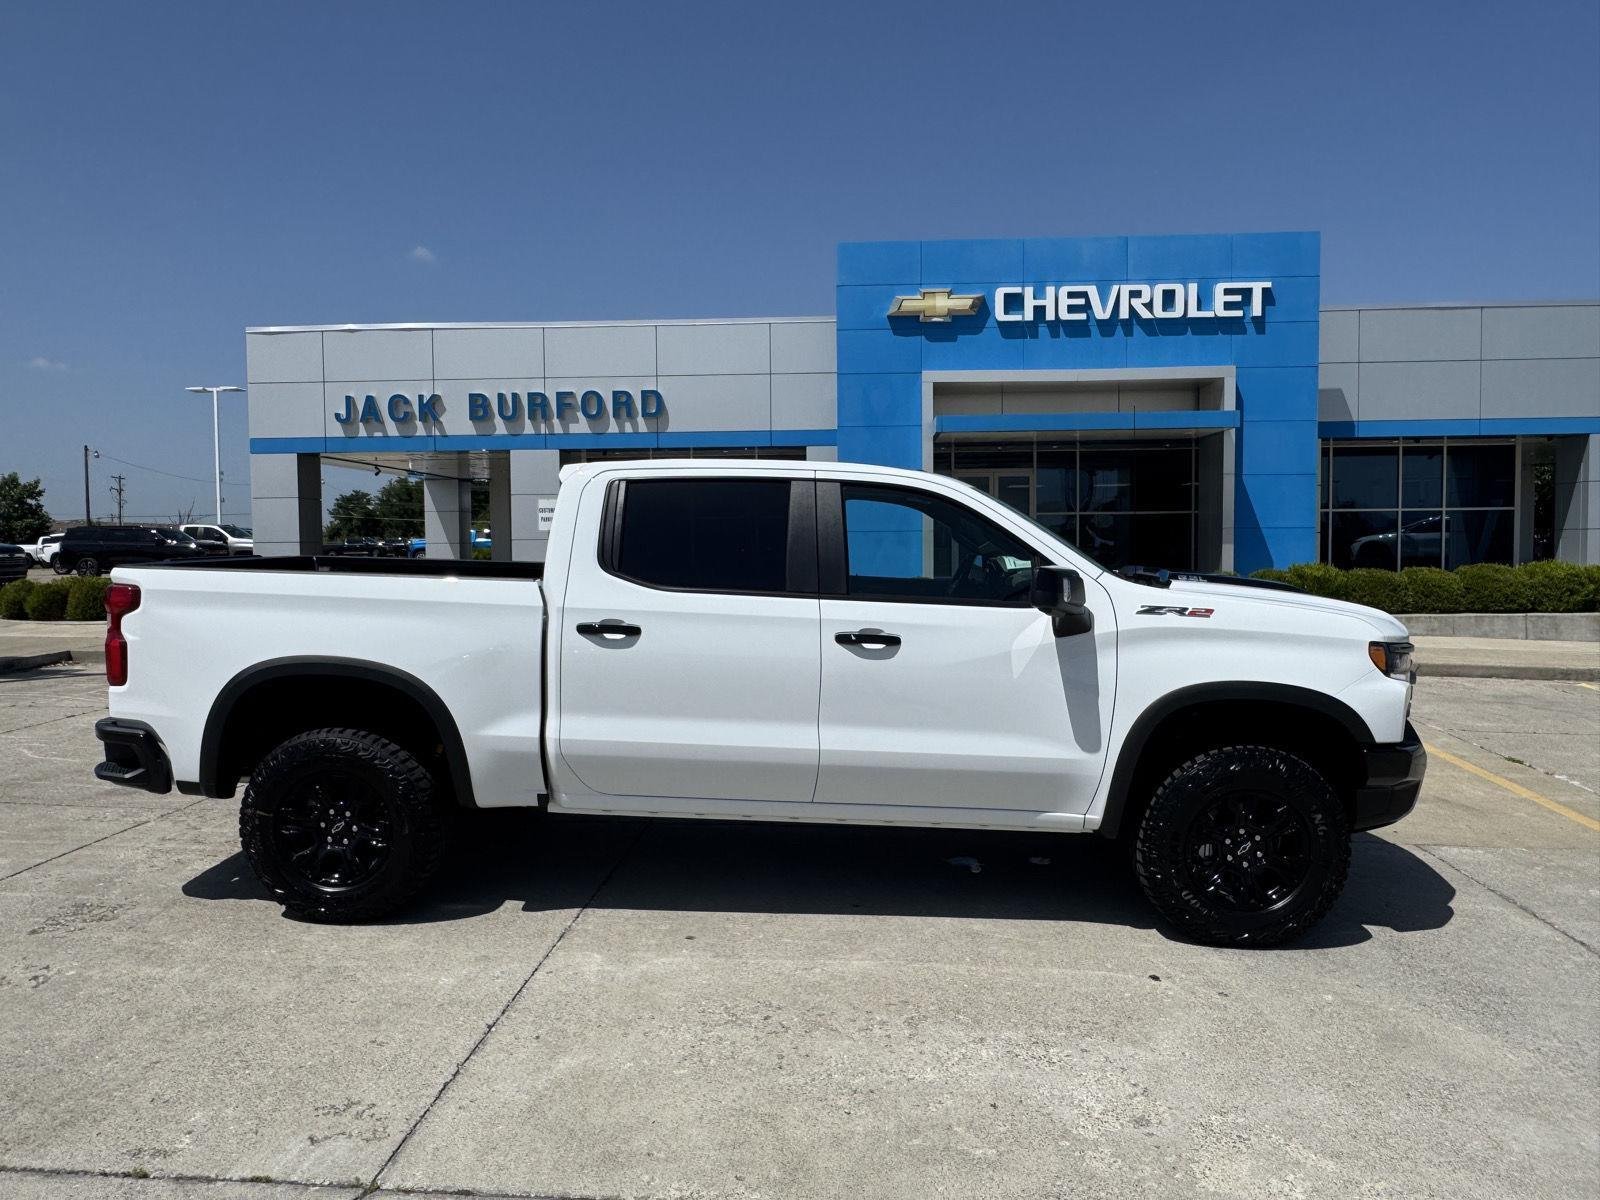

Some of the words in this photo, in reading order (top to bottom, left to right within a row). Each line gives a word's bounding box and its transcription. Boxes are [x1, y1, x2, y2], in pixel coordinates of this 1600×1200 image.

[994, 281, 1272, 322] CHEVROLET
[334, 394, 441, 424] JACK
[467, 389, 664, 422] BURFORD
[1135, 604, 1215, 618] ZR2
